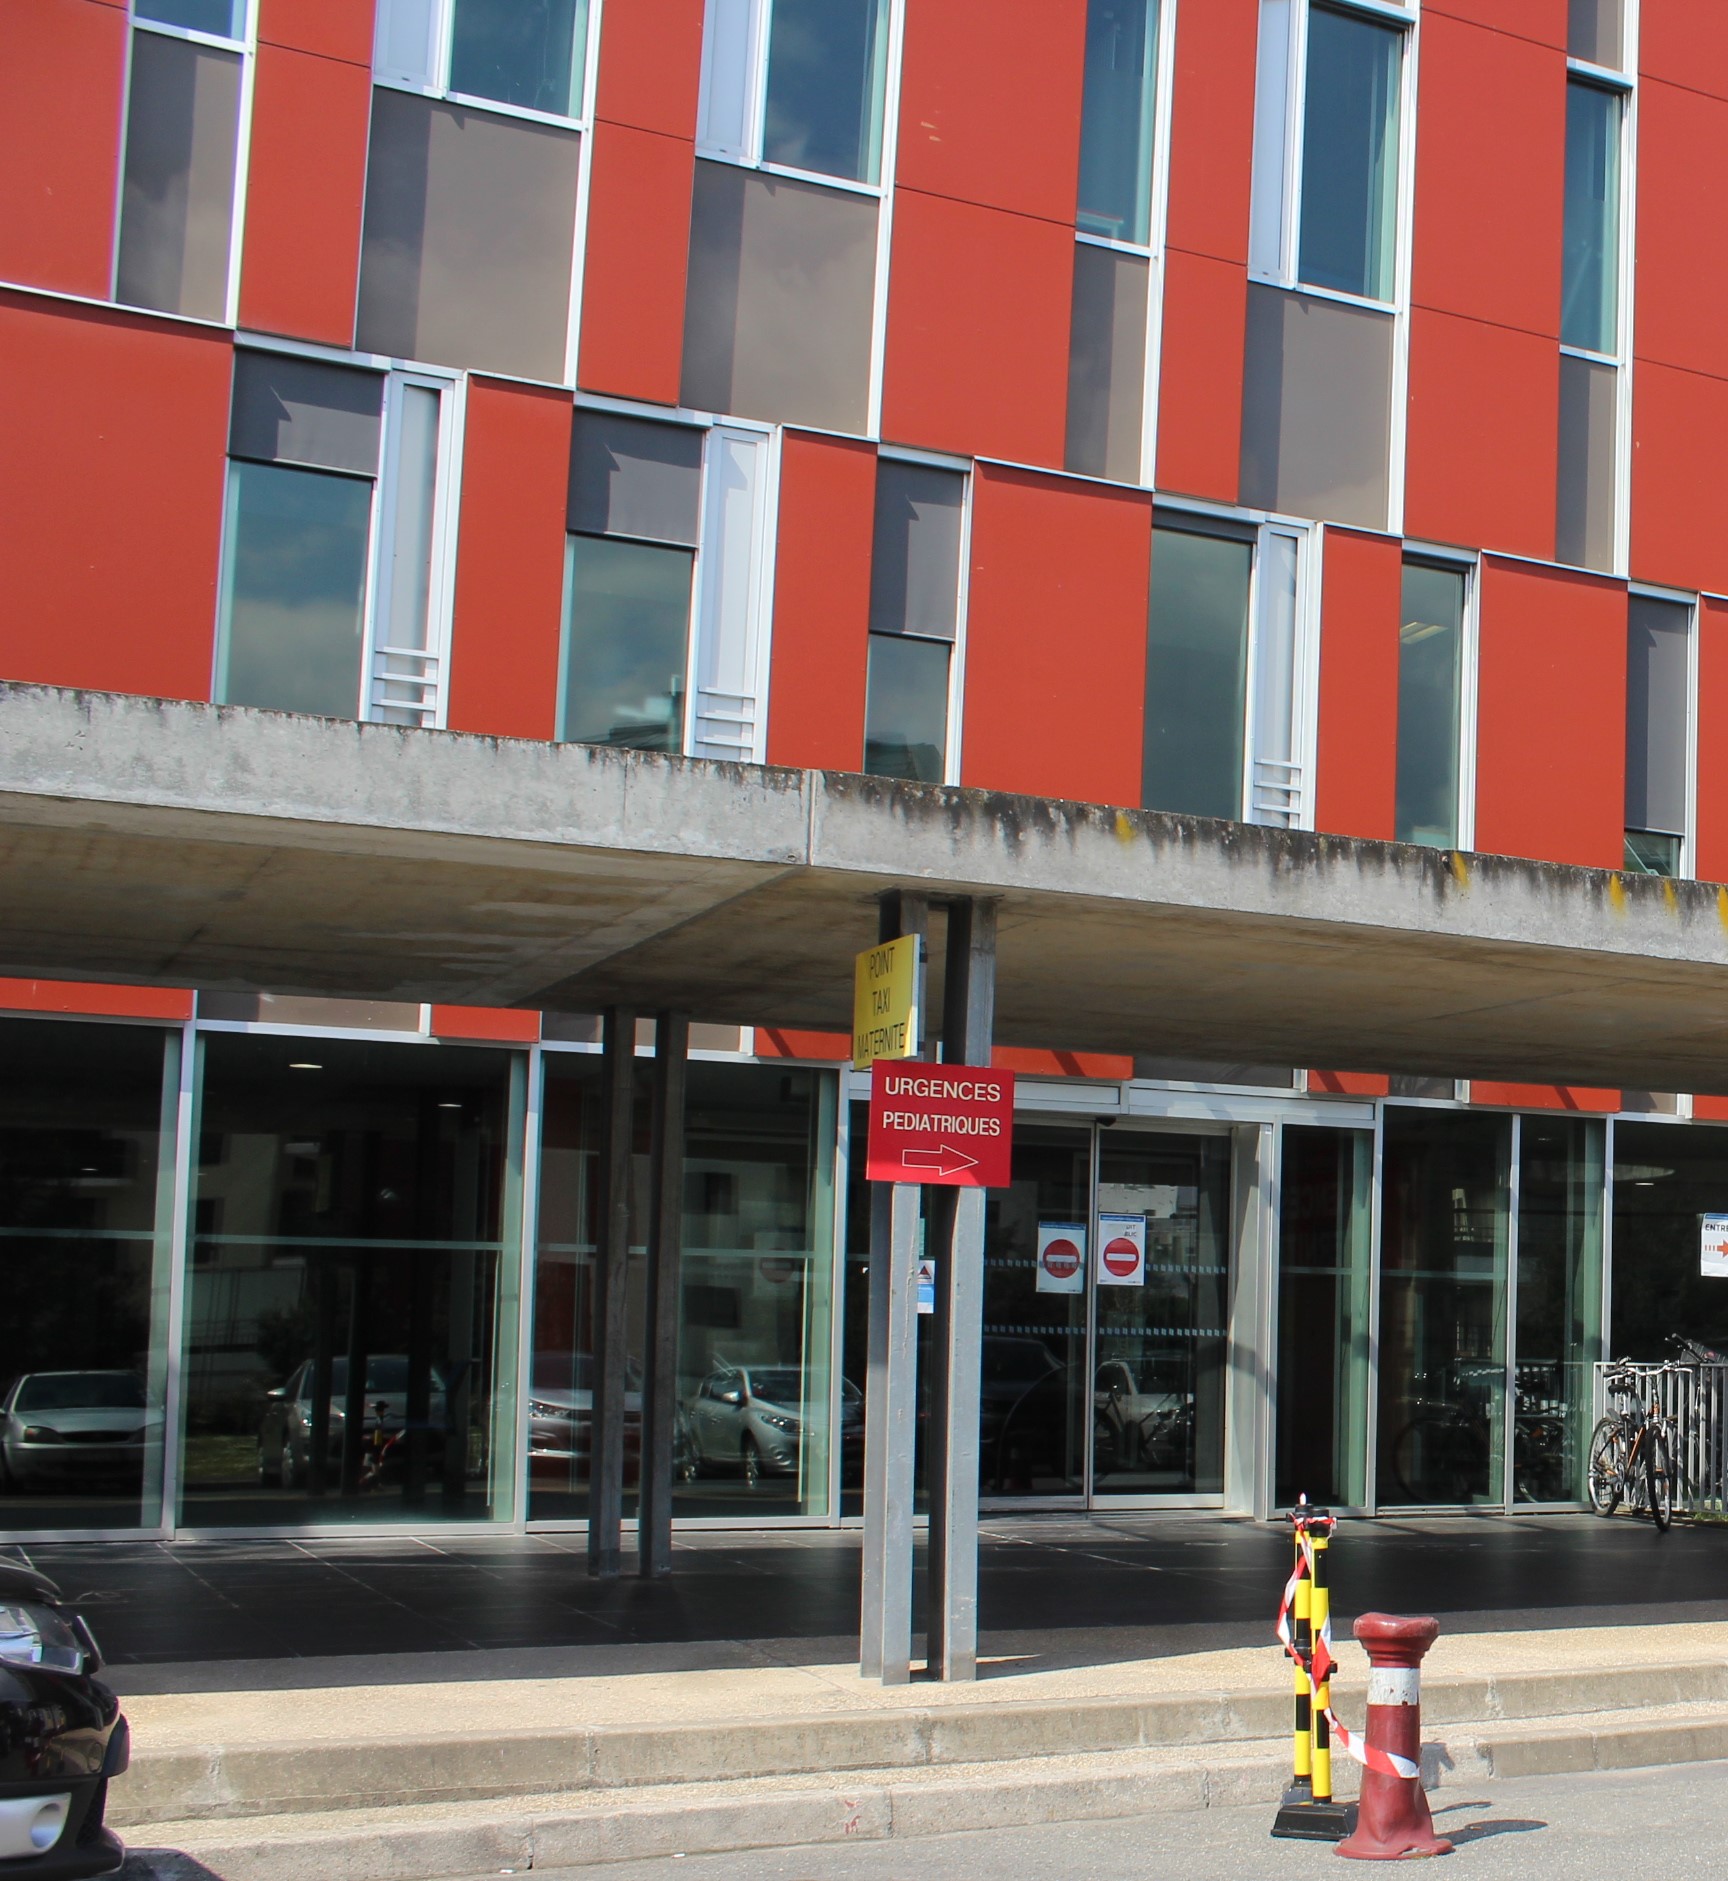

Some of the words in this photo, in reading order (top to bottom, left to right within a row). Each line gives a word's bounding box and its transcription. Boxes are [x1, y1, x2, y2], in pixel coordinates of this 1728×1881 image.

[870, 946, 895, 980] POINT
[872, 987, 891, 1016] TAXI
[858, 1022, 905, 1059] MATERNITE
[885, 1076, 1001, 1102] URGENCES
[882, 1111, 1001, 1136] PEDIATRIQUES
